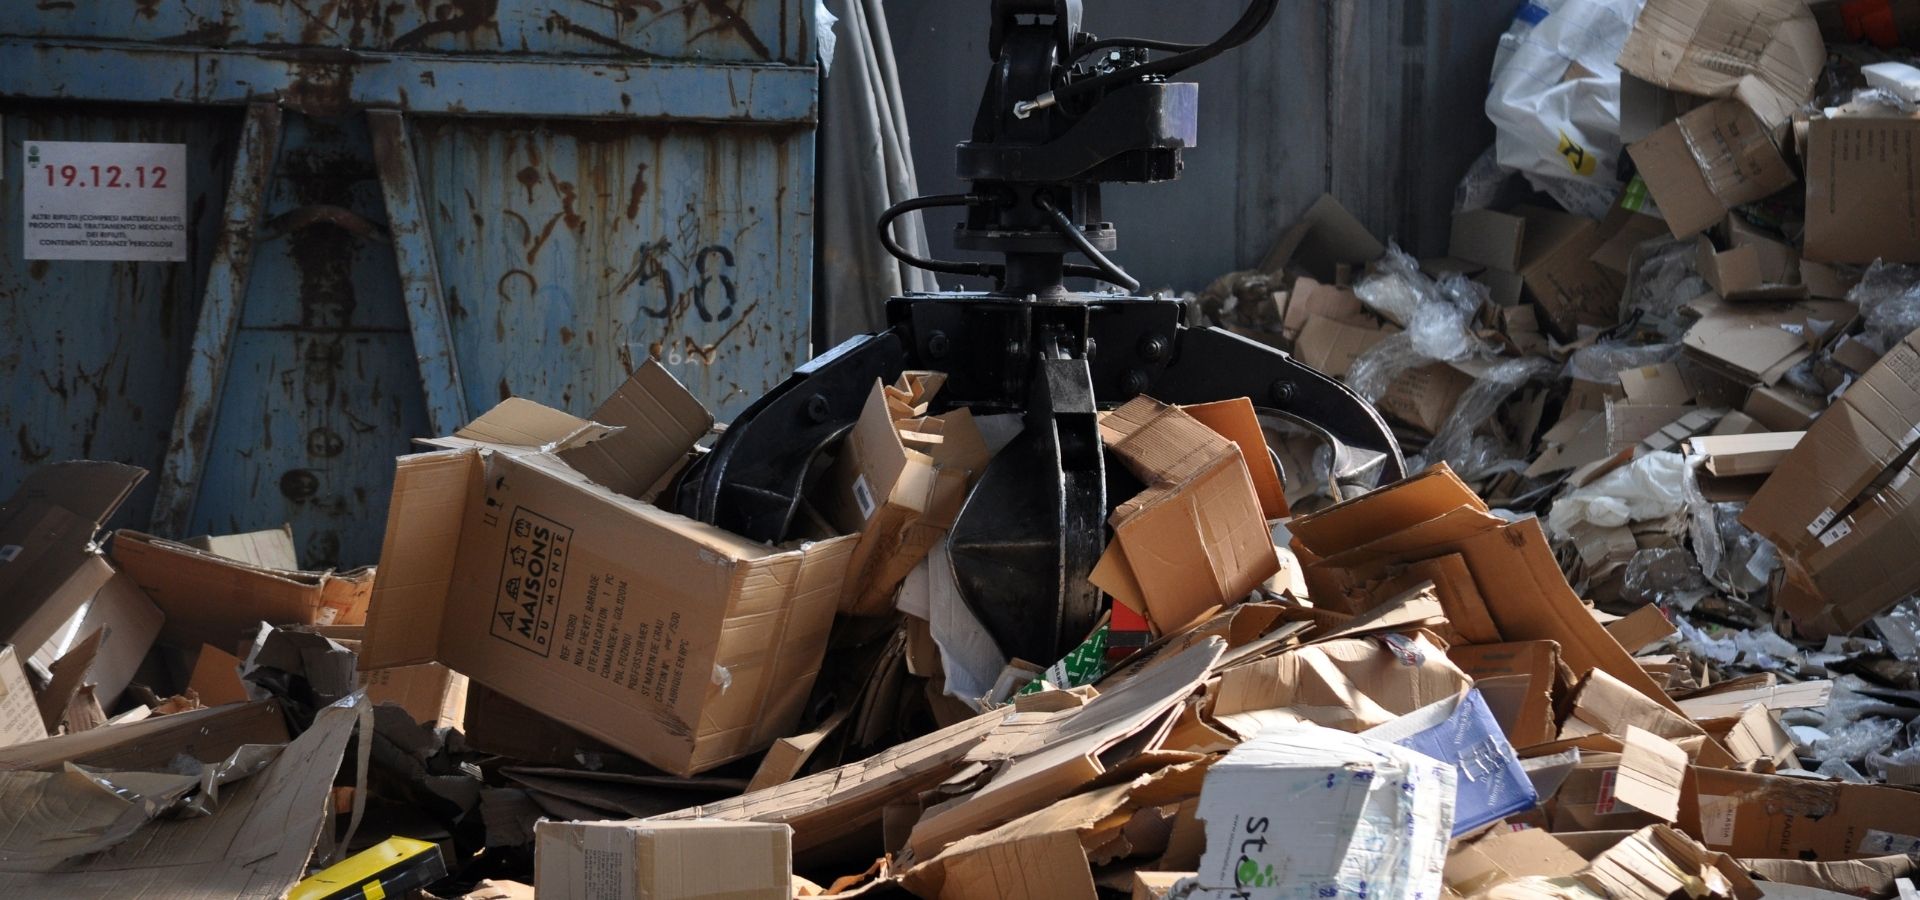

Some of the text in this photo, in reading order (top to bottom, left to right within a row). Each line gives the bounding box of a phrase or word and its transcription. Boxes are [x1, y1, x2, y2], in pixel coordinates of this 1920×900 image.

[44, 165, 167, 188] 19.12.12
[517, 526, 550, 638] MAISONS
[537, 534, 565, 645] DU MONDE
